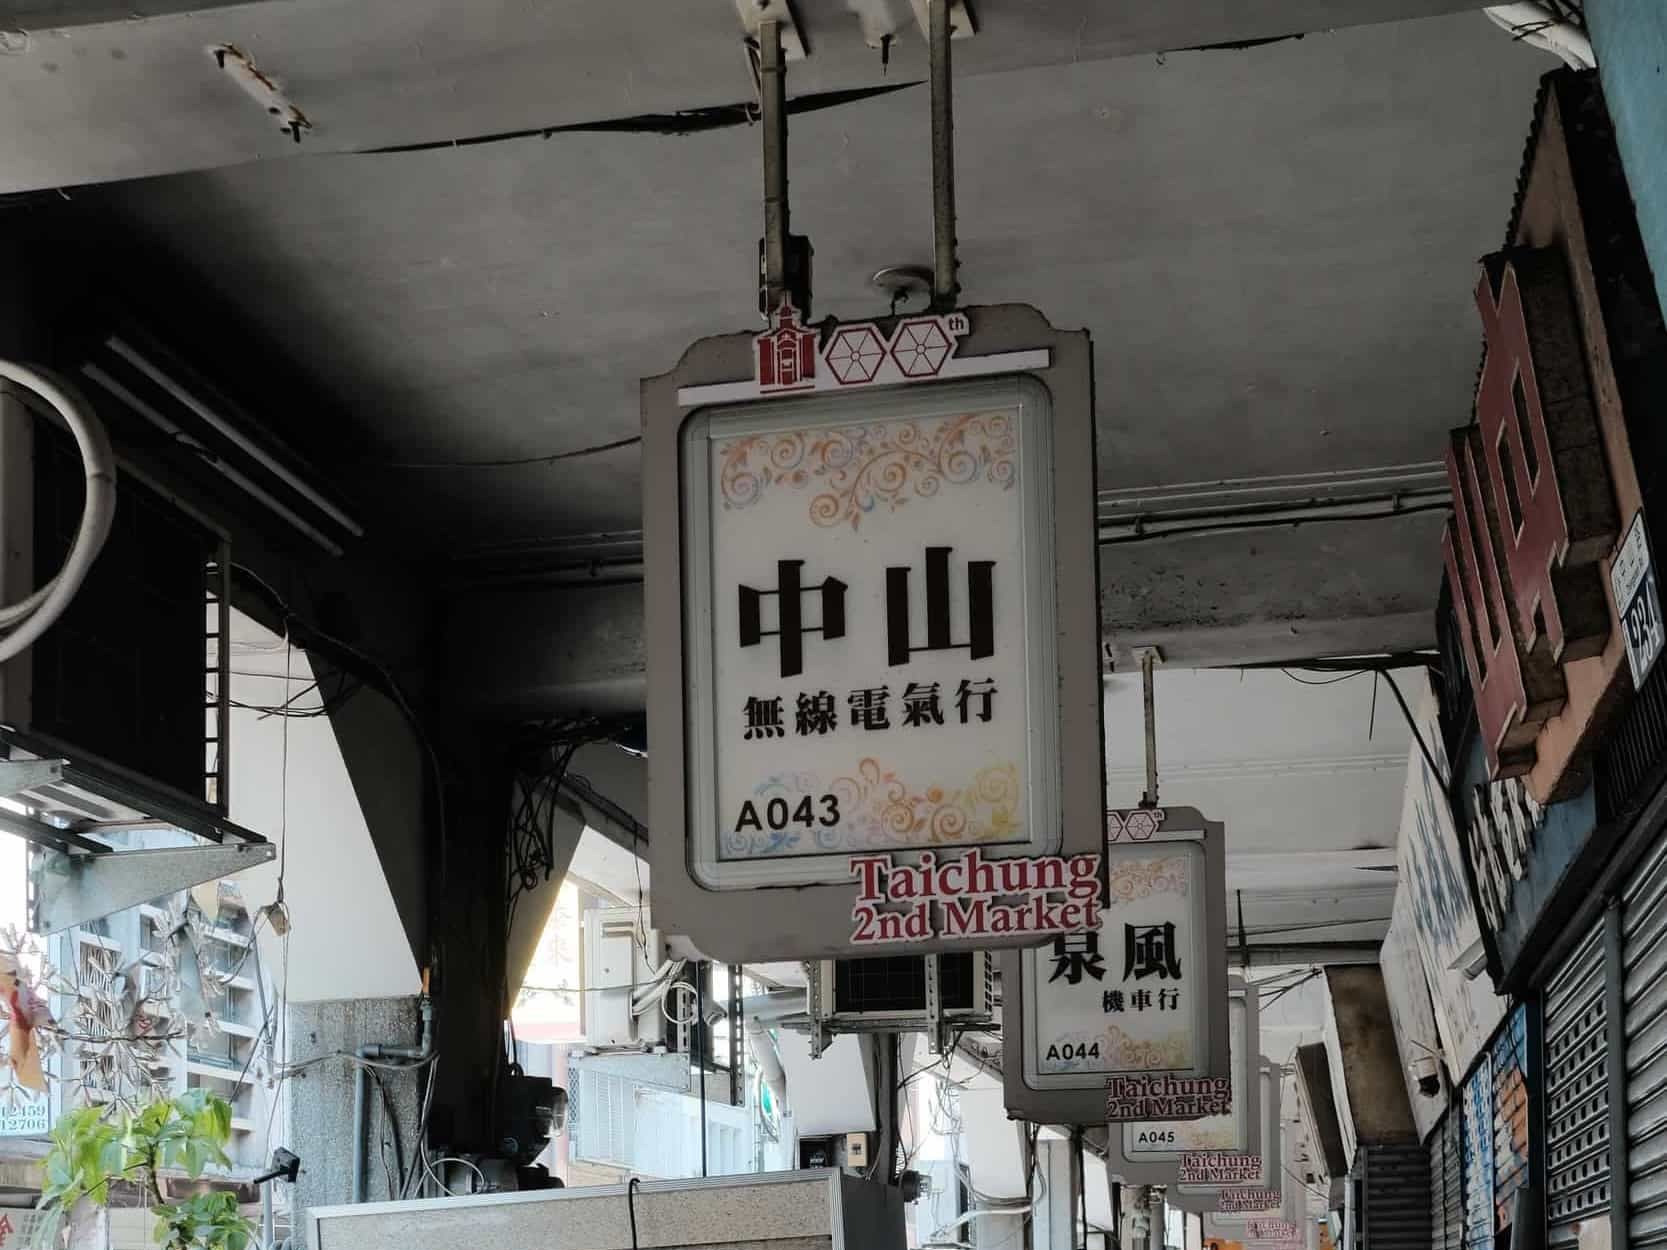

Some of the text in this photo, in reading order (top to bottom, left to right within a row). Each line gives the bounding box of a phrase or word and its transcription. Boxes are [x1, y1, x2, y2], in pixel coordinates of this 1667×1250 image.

[737, 546, 996, 678] 中山
[742, 678, 998, 740] 無線電氣行
[735, 793, 842, 833] A043
[851, 850, 1100, 902] Taichung
[852, 896, 1102, 942] 2nd Market
[1047, 922, 1182, 985] 泉風
[1102, 986, 1181, 1014] 機車行
[1045, 1041, 1101, 1062] A044
[1107, 1075, 1229, 1100] Taichung
[1107, 1096, 1228, 1118] 2nd Market
[1138, 1131, 1176, 1144] A045
[1182, 1154, 1263, 1171] Taichung
[1209, 1167, 1262, 1181] Market
